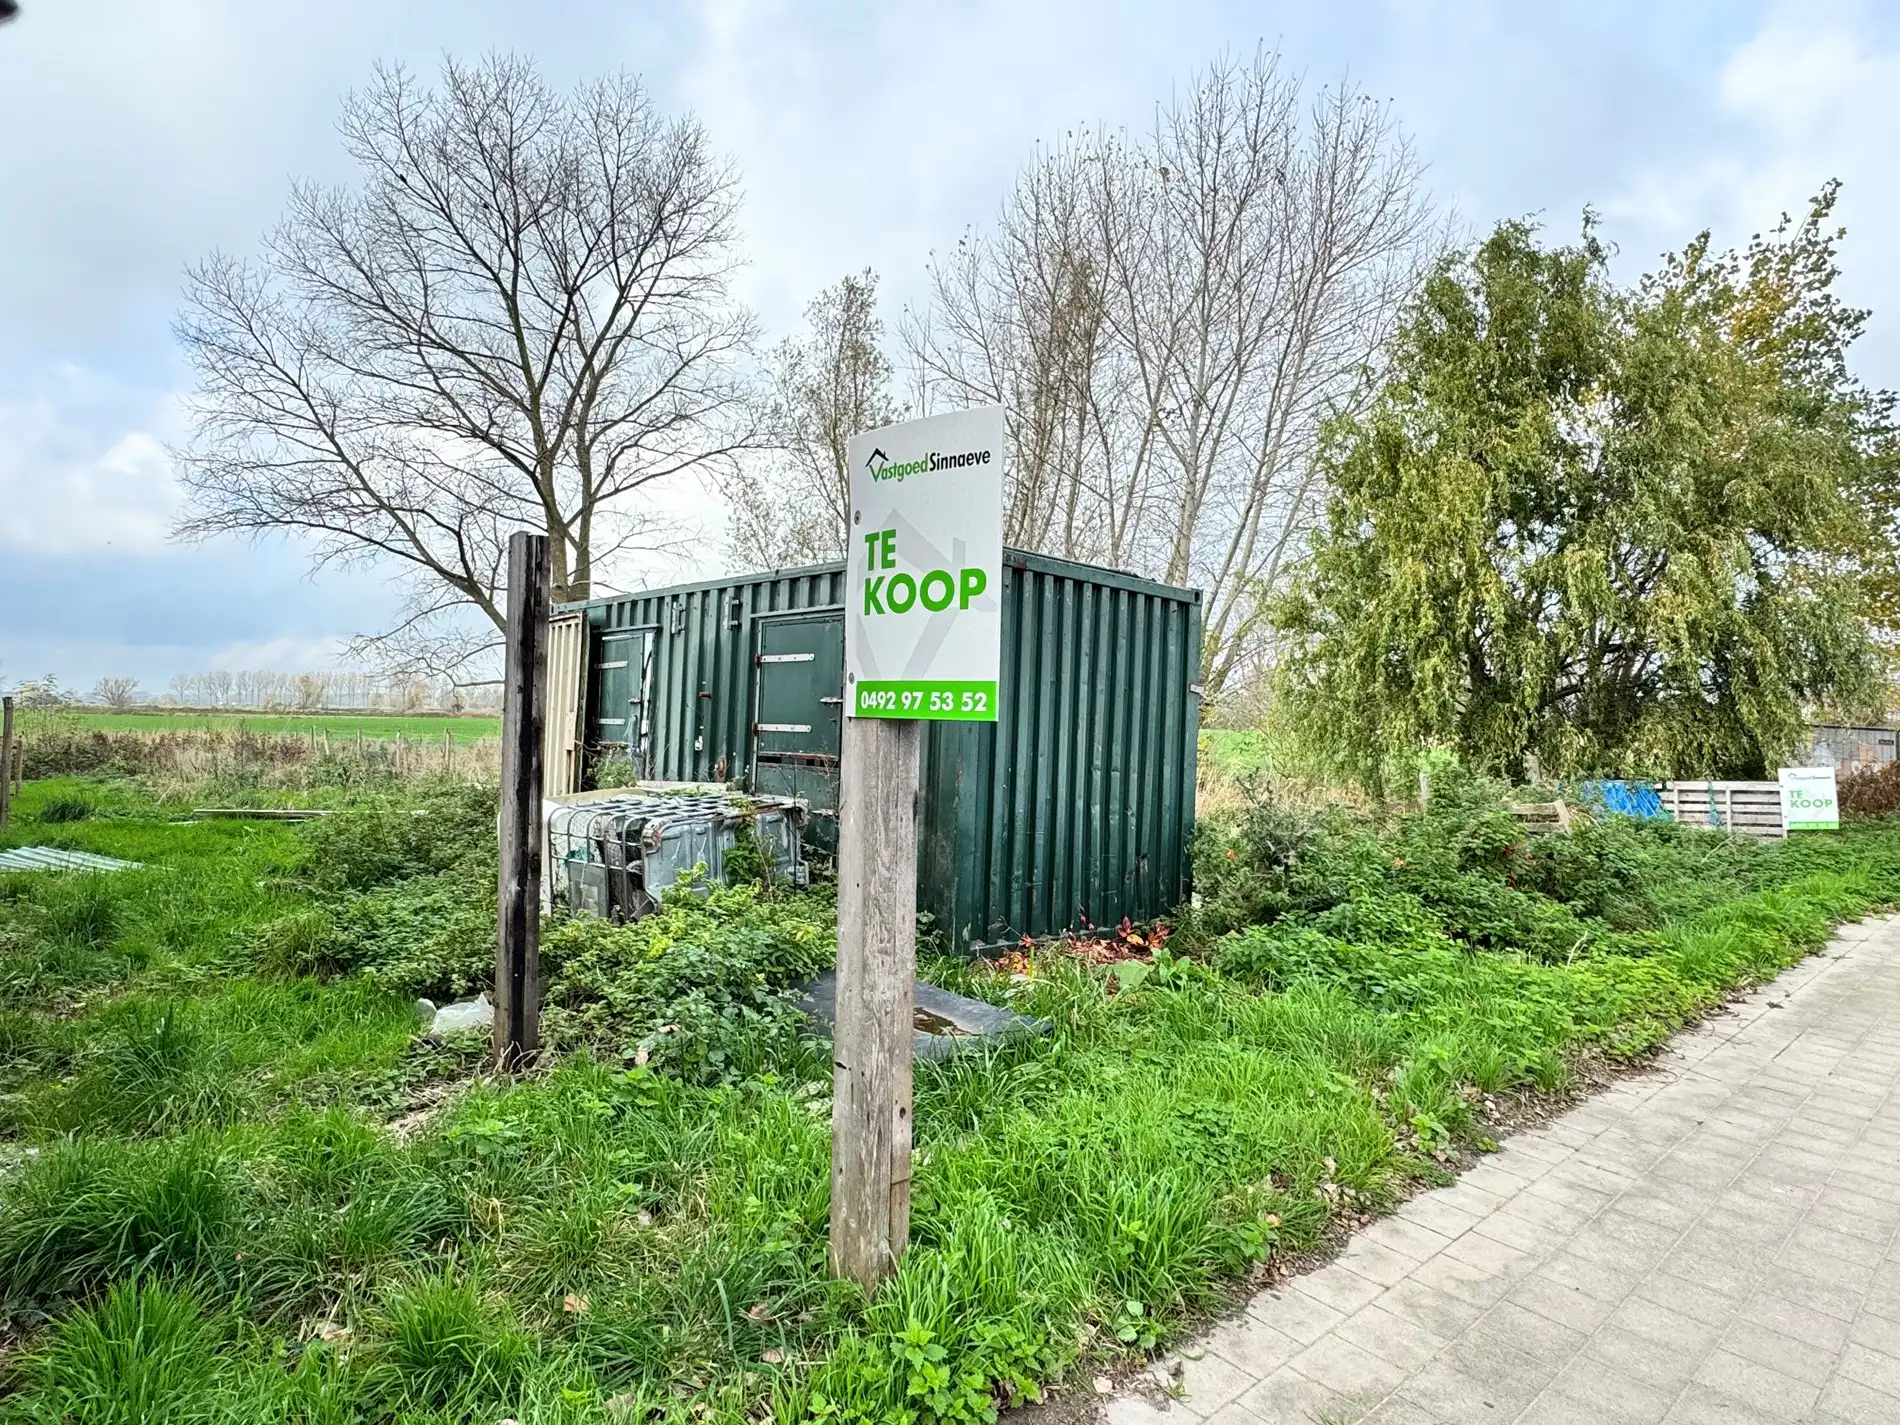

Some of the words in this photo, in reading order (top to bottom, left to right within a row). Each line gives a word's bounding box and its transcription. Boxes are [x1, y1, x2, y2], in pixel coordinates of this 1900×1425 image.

[865, 529, 897, 571] TE
[864, 568, 987, 615] KOOP
[861, 690, 896, 711] 0492
[901, 691, 924, 711] 97
[930, 692, 954, 712] 53
[961, 692, 987, 712] 52
[1788, 790, 1803, 799] TE
[1790, 799, 1833, 808] KOOP
